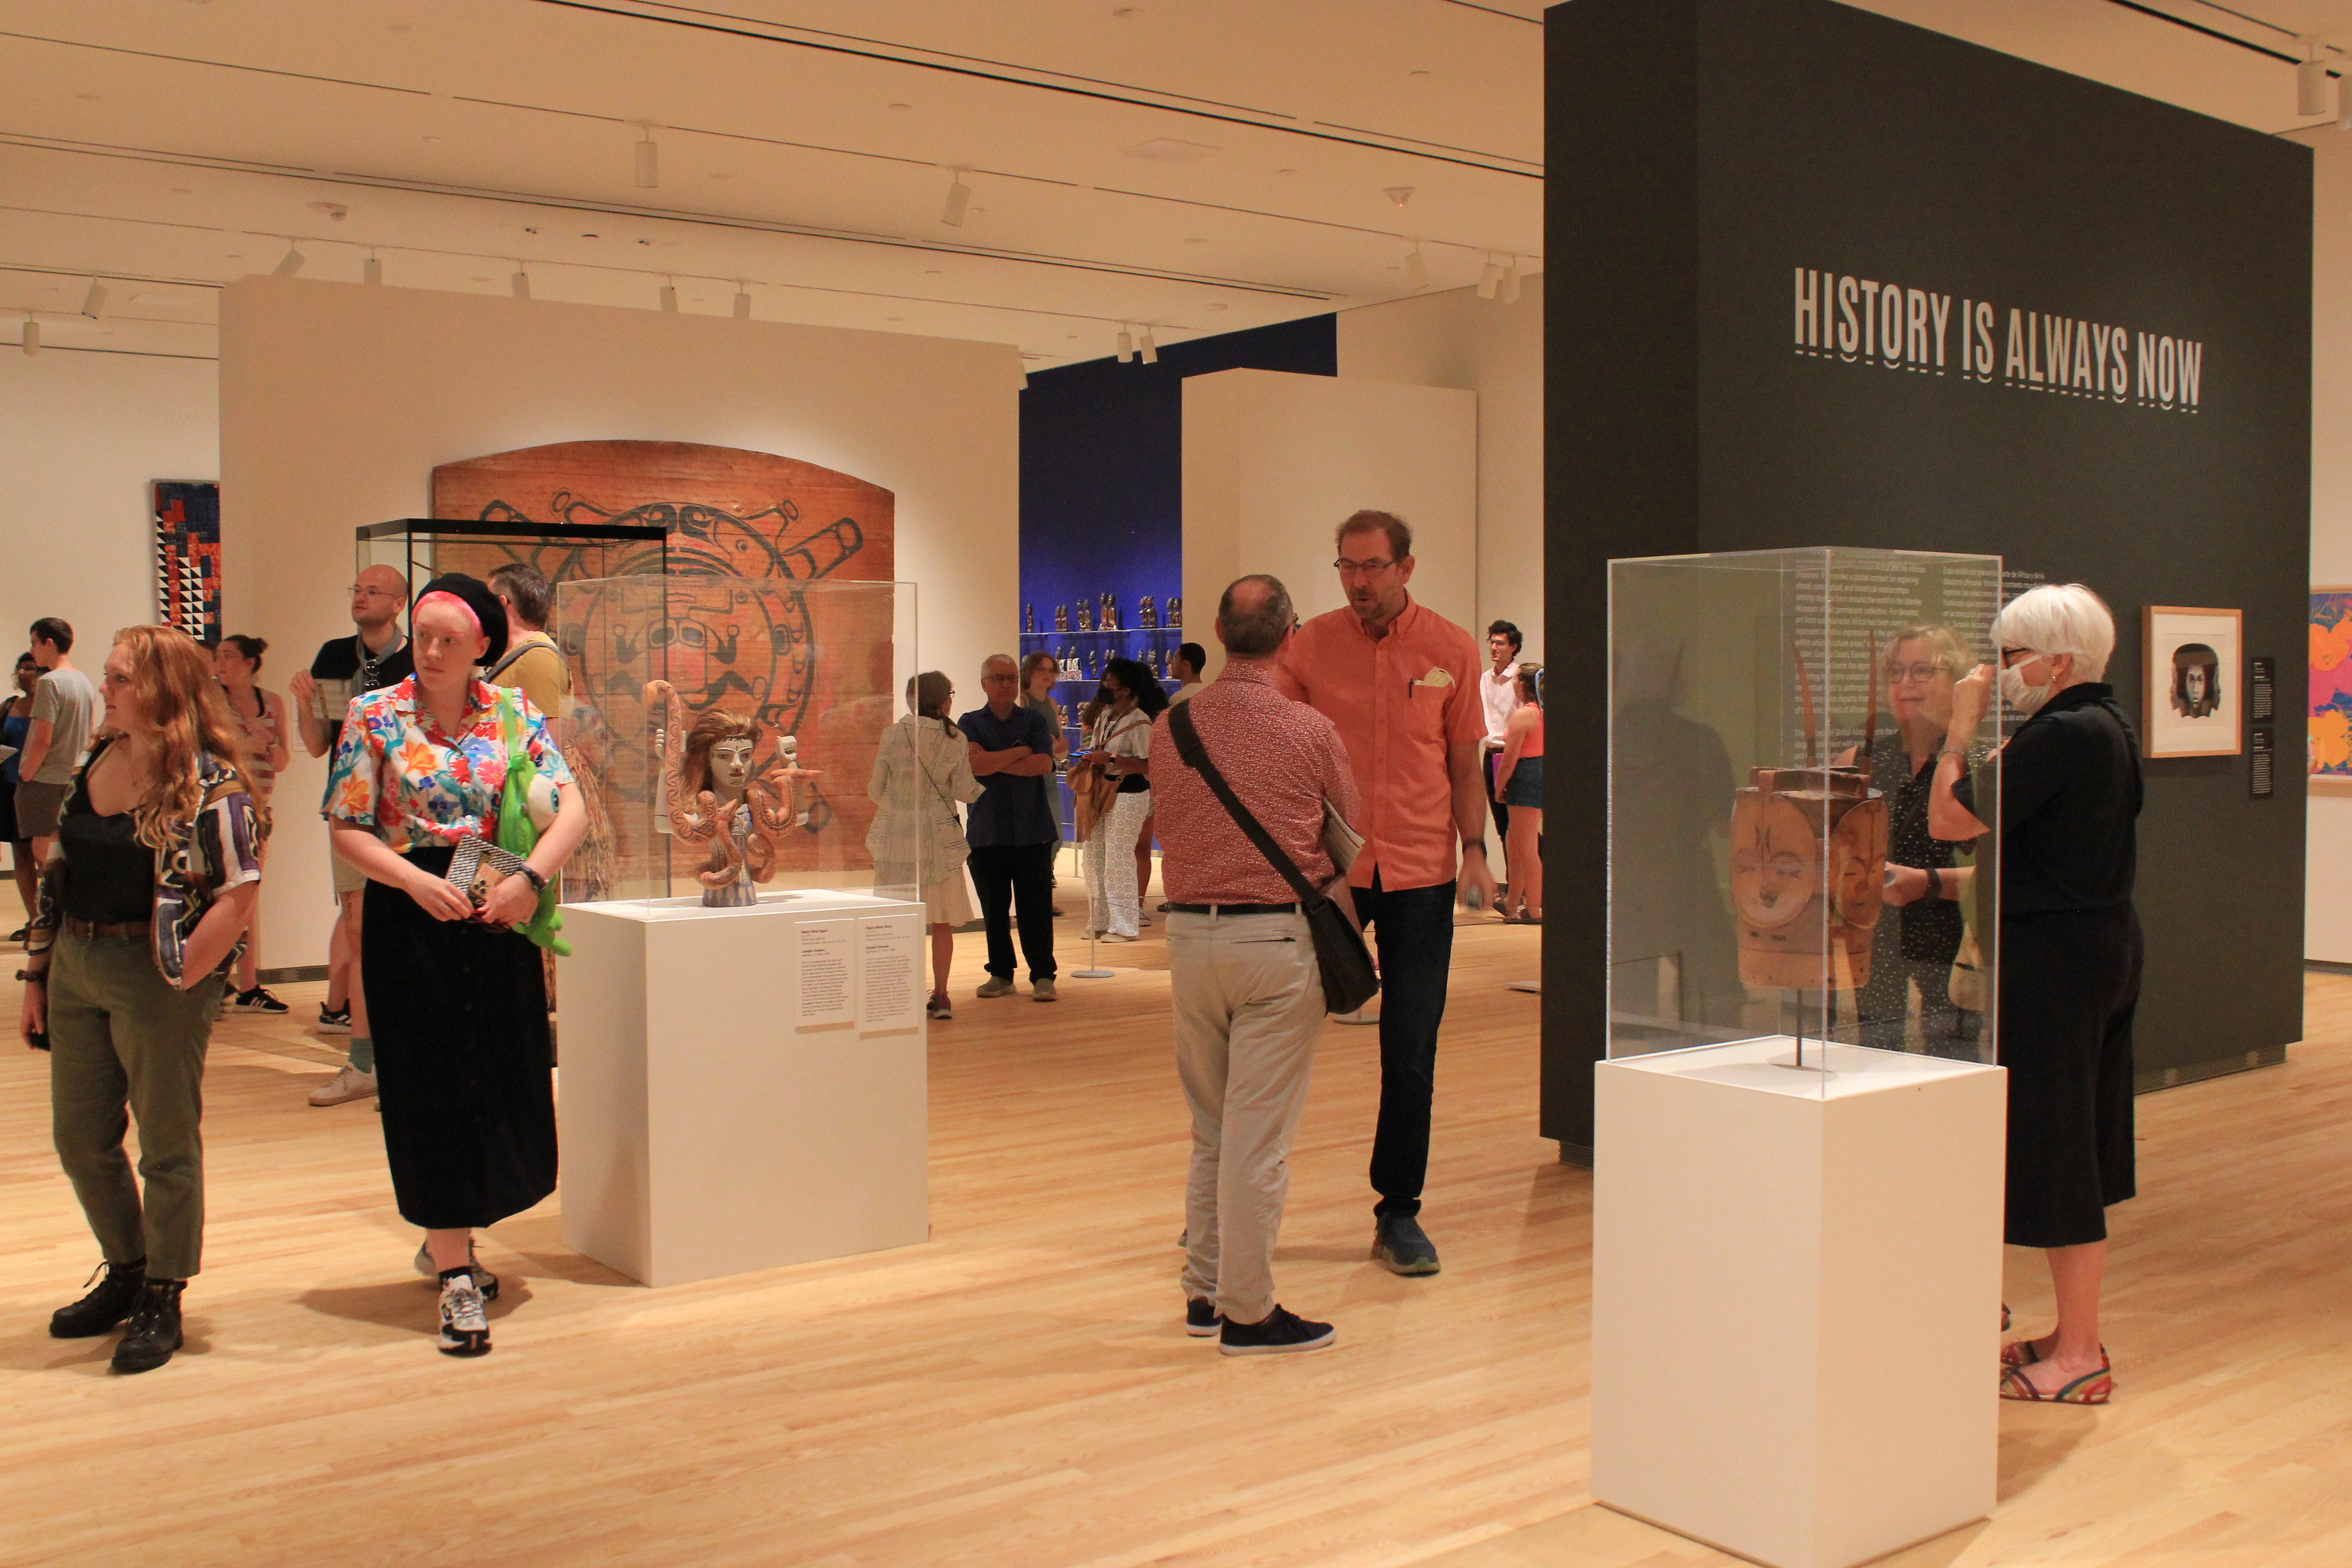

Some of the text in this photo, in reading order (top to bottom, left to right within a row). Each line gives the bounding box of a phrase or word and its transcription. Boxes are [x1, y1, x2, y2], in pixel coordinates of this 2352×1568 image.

[1795, 268, 2201, 406] HISTORY IS ALWAYS NOW
